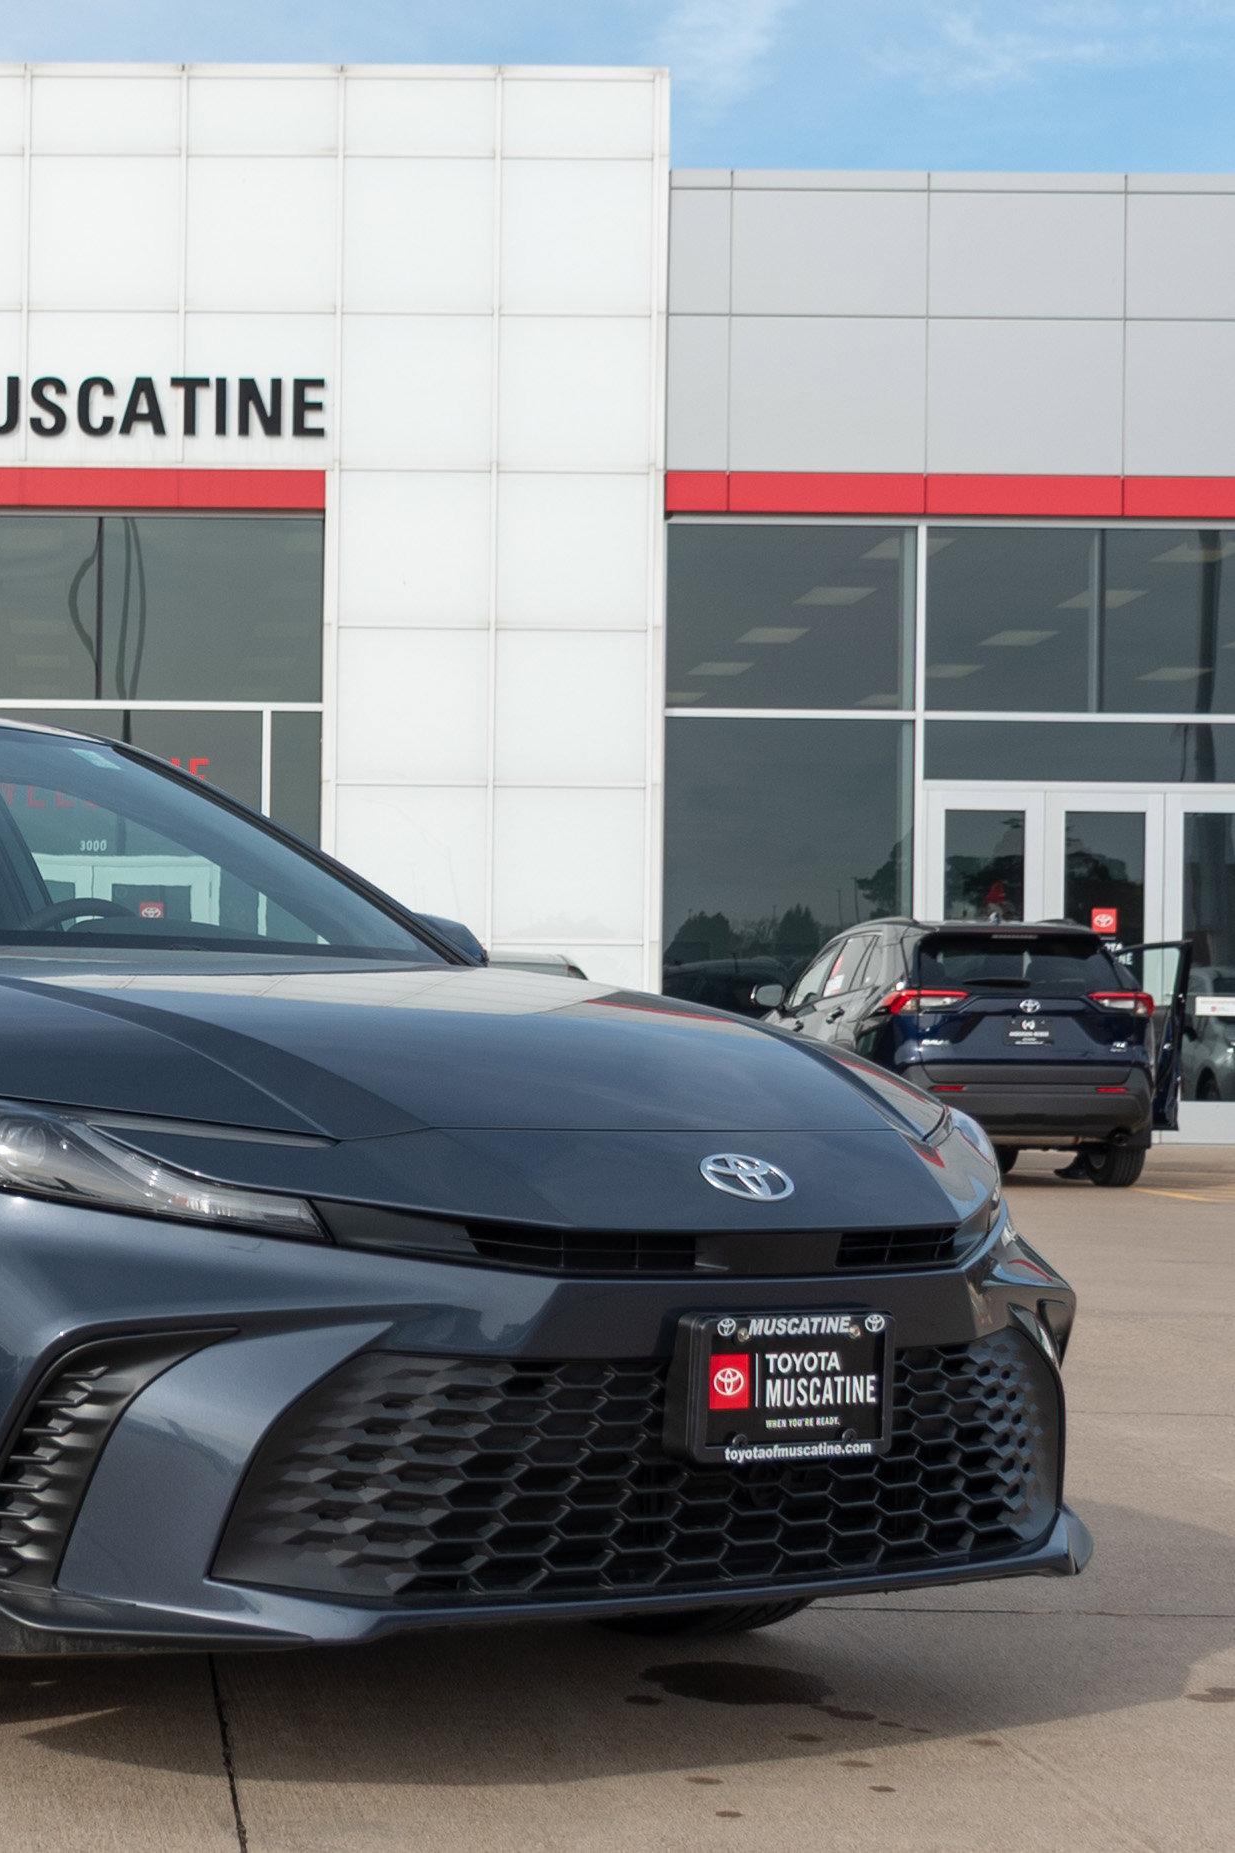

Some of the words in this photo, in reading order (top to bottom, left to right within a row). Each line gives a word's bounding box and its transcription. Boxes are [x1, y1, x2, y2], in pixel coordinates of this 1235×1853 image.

[79, 839, 107, 852] 3000
[748, 1316, 851, 1336] MUSCATINE
[765, 1352, 841, 1374] TOYOTA
[765, 1375, 877, 1408] MUSCATINE
[765, 1419, 787, 1429] WHEN
[724, 1442, 872, 1463] toyotaofmuscatine.com
